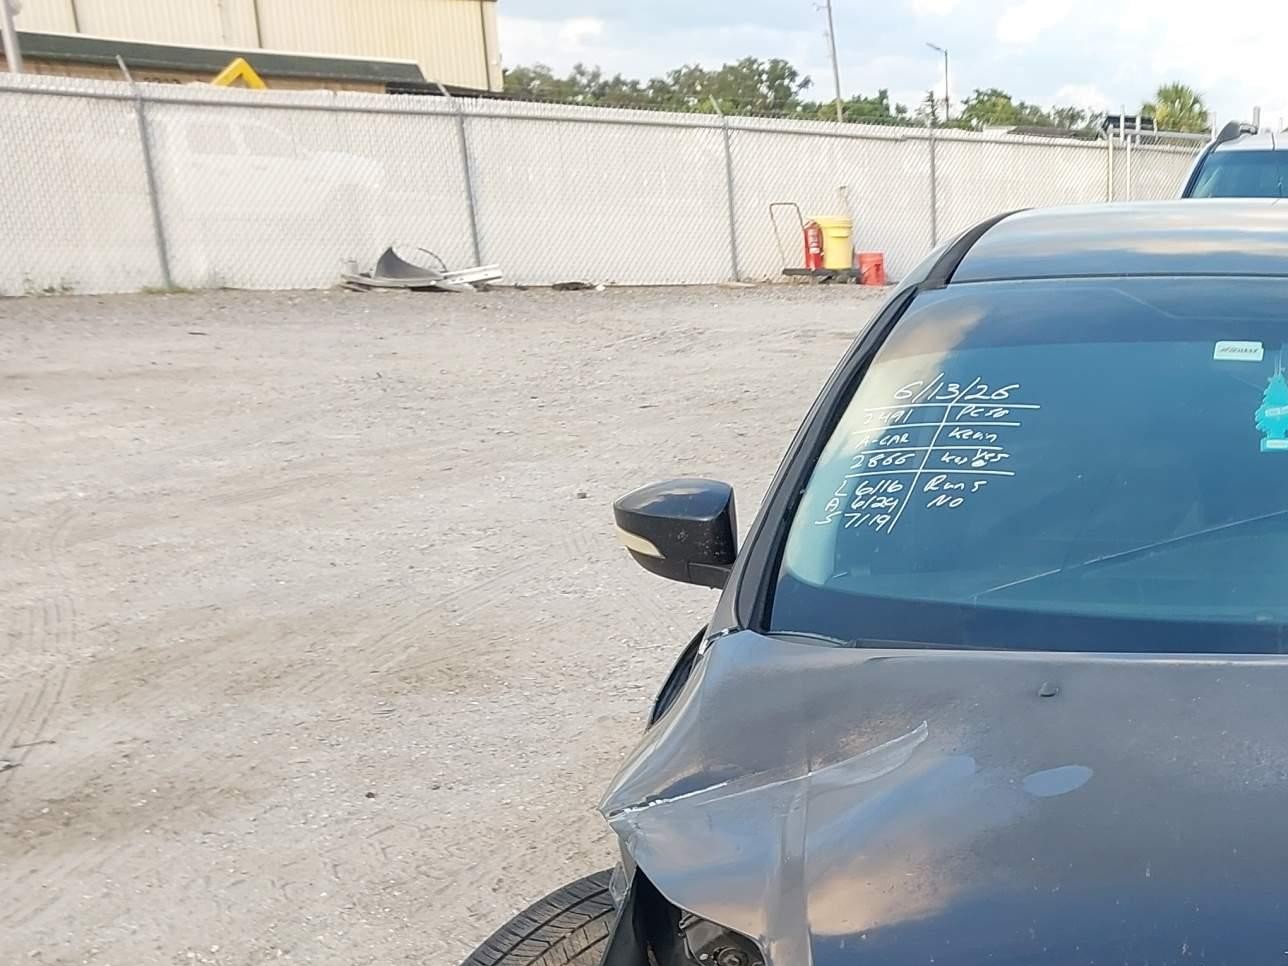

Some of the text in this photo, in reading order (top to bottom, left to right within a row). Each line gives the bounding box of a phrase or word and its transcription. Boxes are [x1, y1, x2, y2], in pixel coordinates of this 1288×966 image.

[894, 372, 1020, 403] 6/13/26
[850, 452, 916, 469] 2866
[855, 479, 904, 496] 6/16
